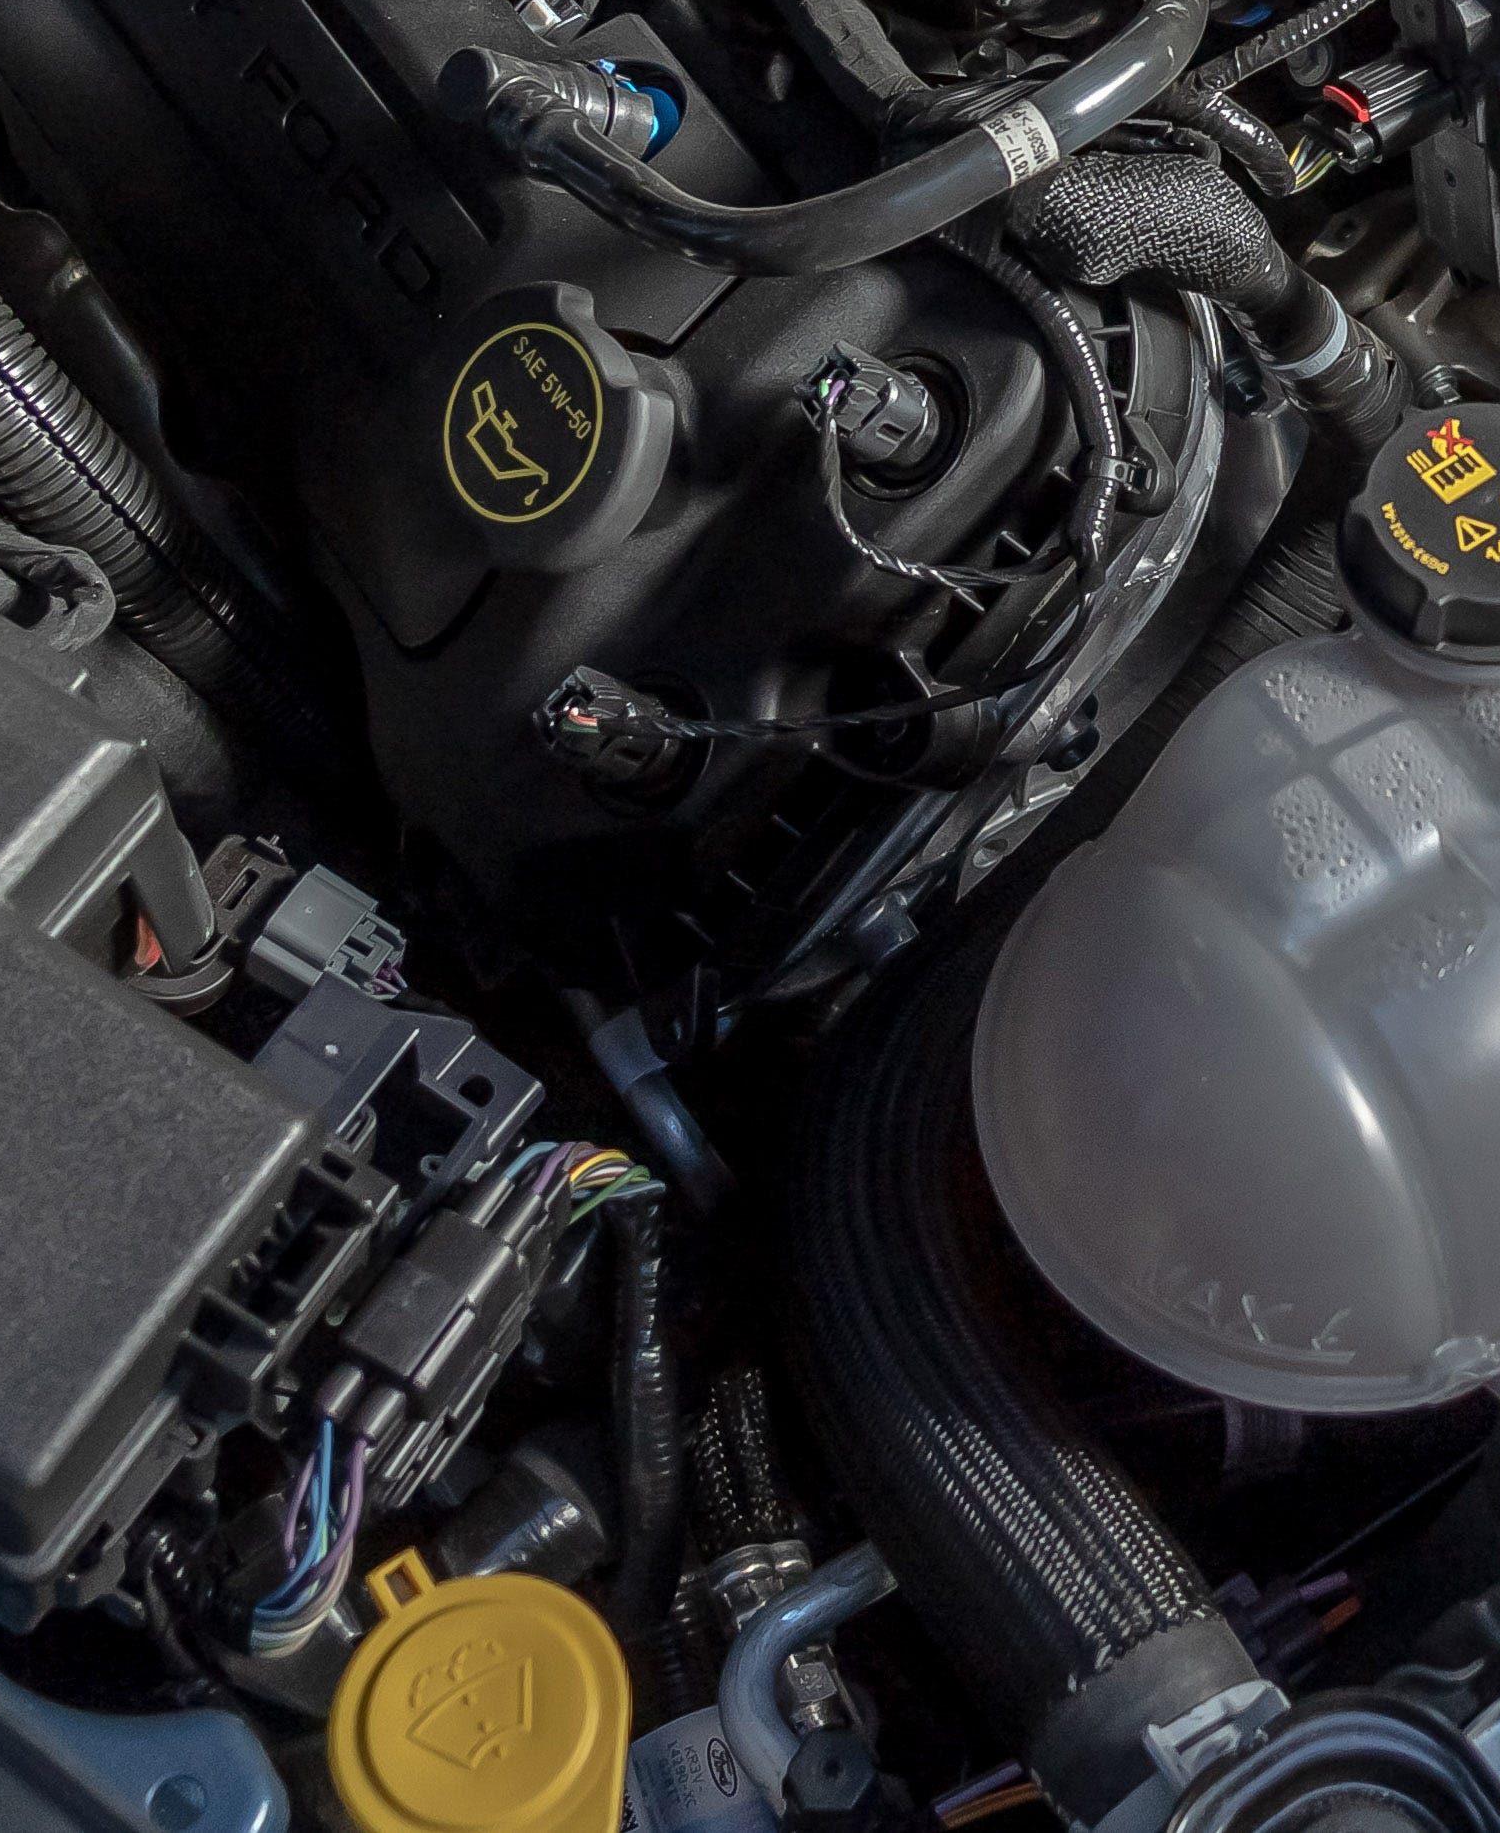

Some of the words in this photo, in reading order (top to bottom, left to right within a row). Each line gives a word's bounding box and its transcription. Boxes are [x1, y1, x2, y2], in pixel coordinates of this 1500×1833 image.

[244, 47, 438, 296] FORD
[513, 336, 545, 380] SAE
[541, 373, 592, 439] 5W-50
